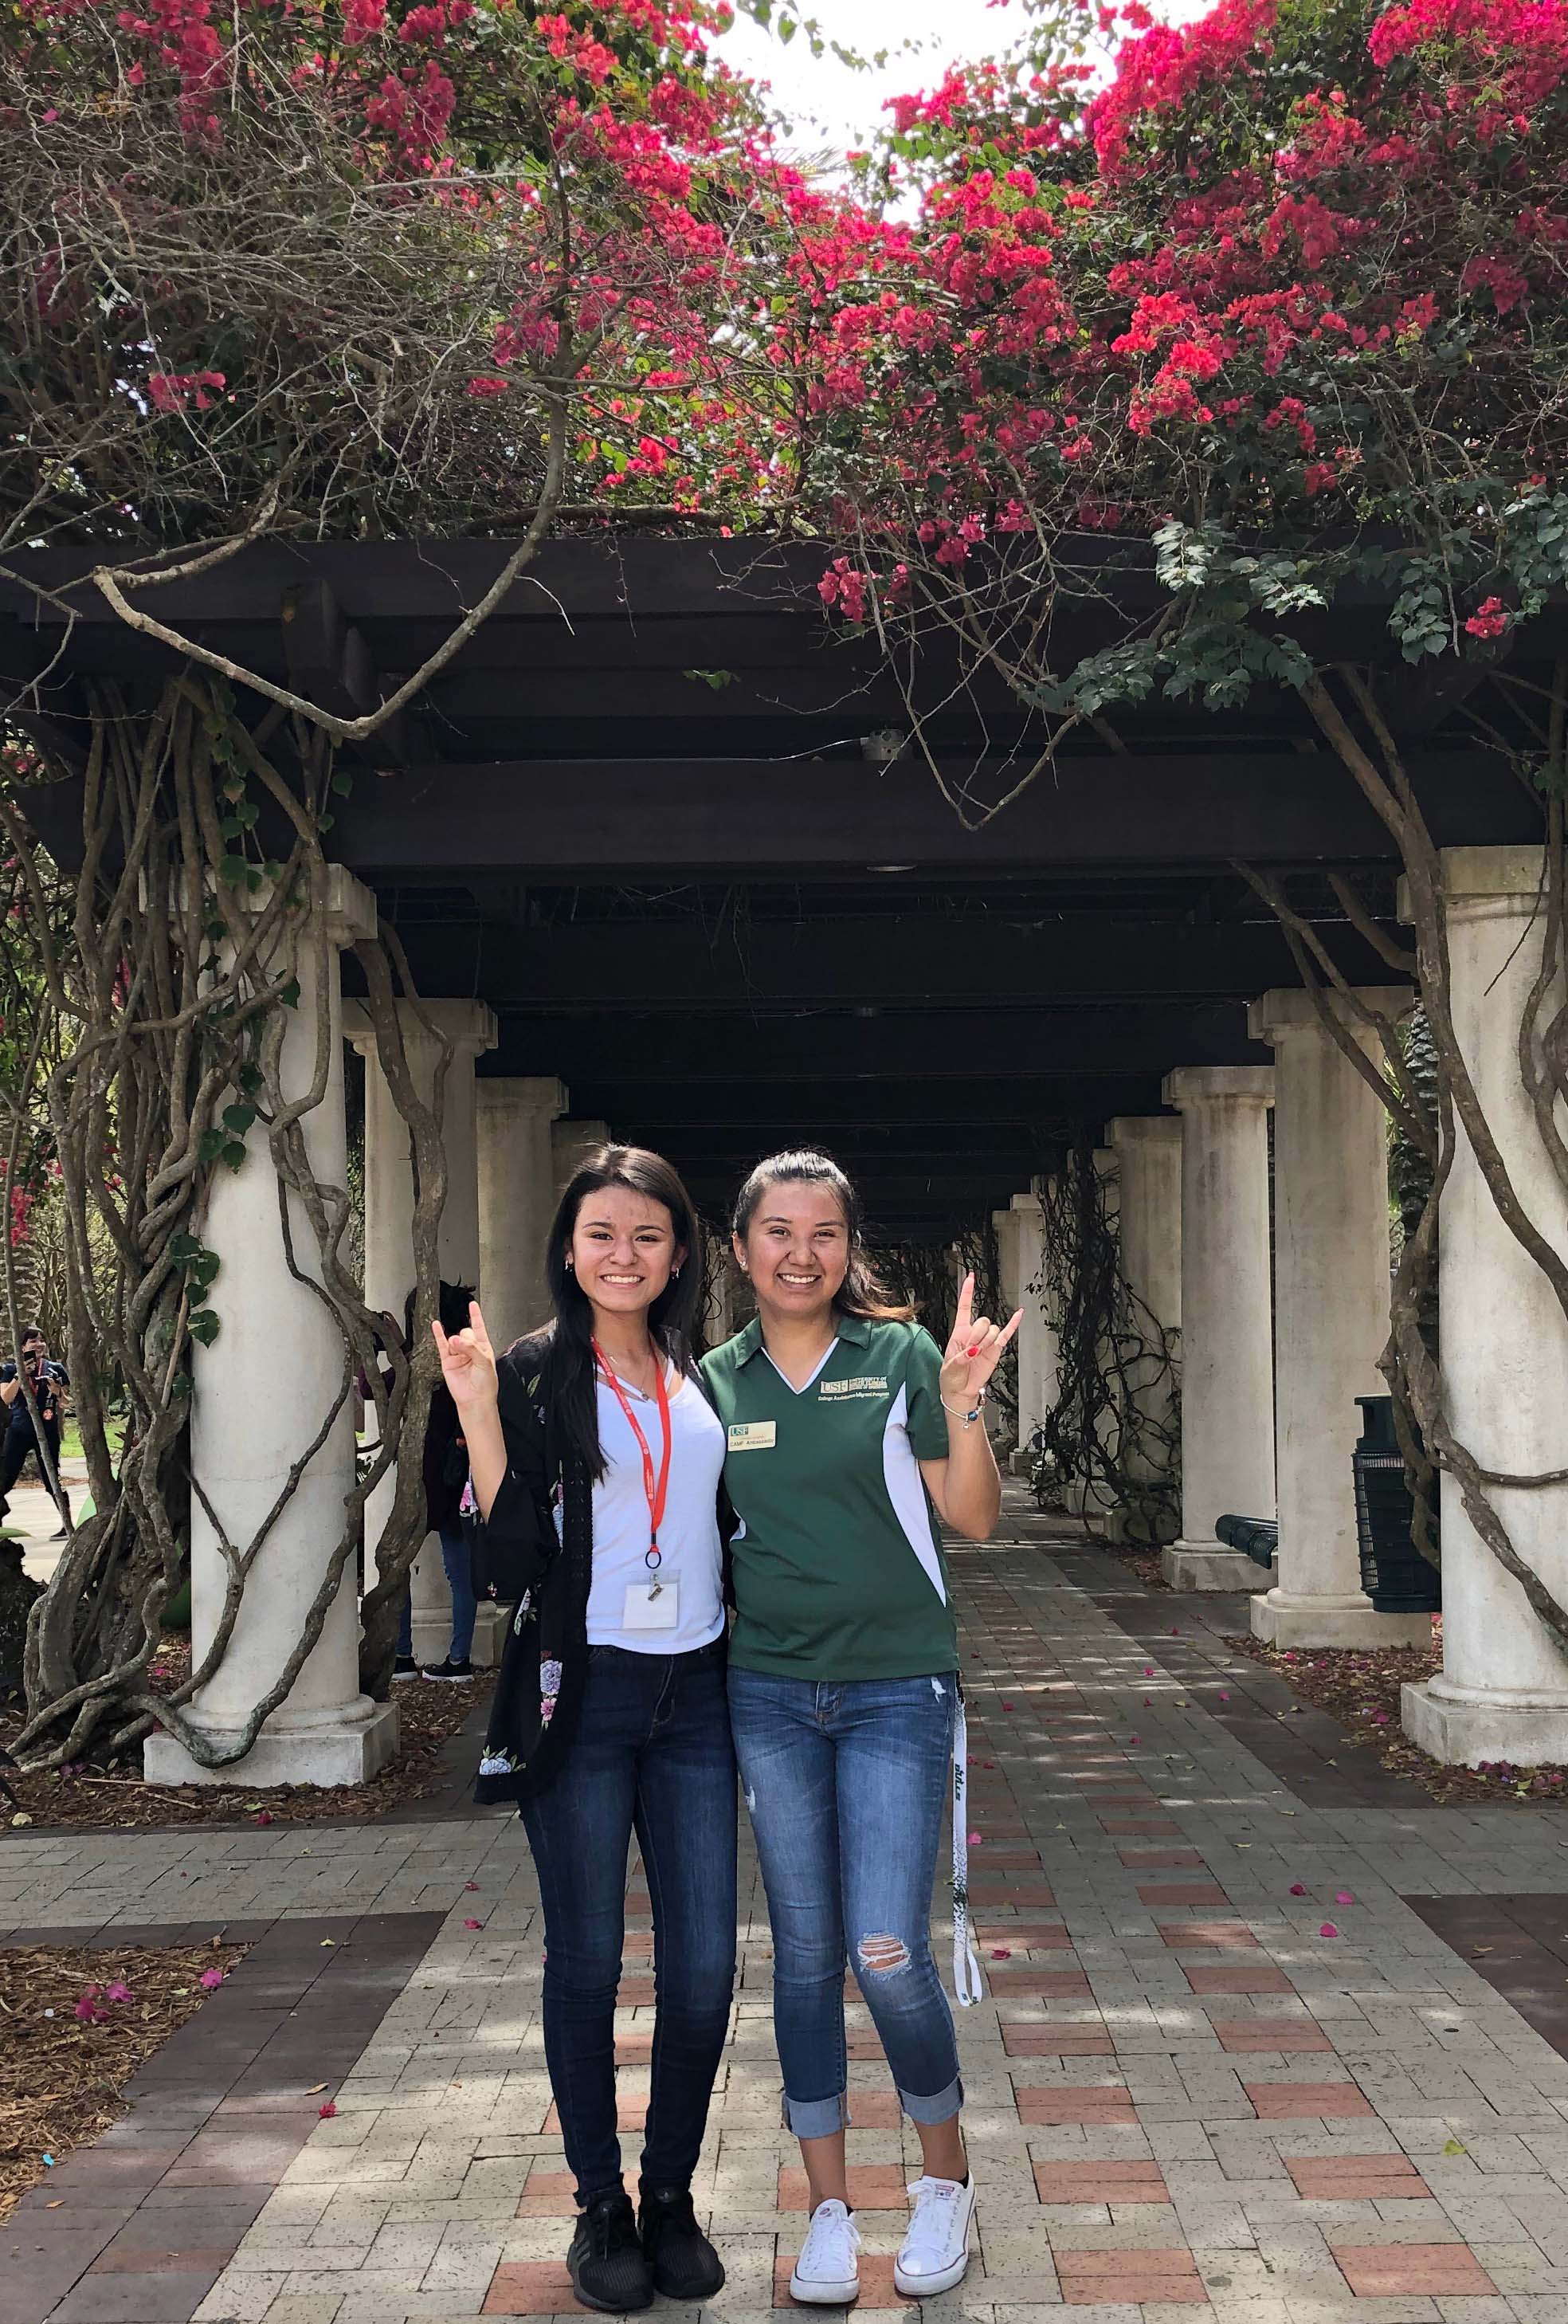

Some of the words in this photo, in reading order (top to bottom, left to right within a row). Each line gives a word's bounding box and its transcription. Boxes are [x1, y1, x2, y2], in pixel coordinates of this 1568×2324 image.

[822, 1382, 847, 1393] USF
[731, 1427, 748, 1436] USF
[955, 1763, 965, 1801] BULLS
